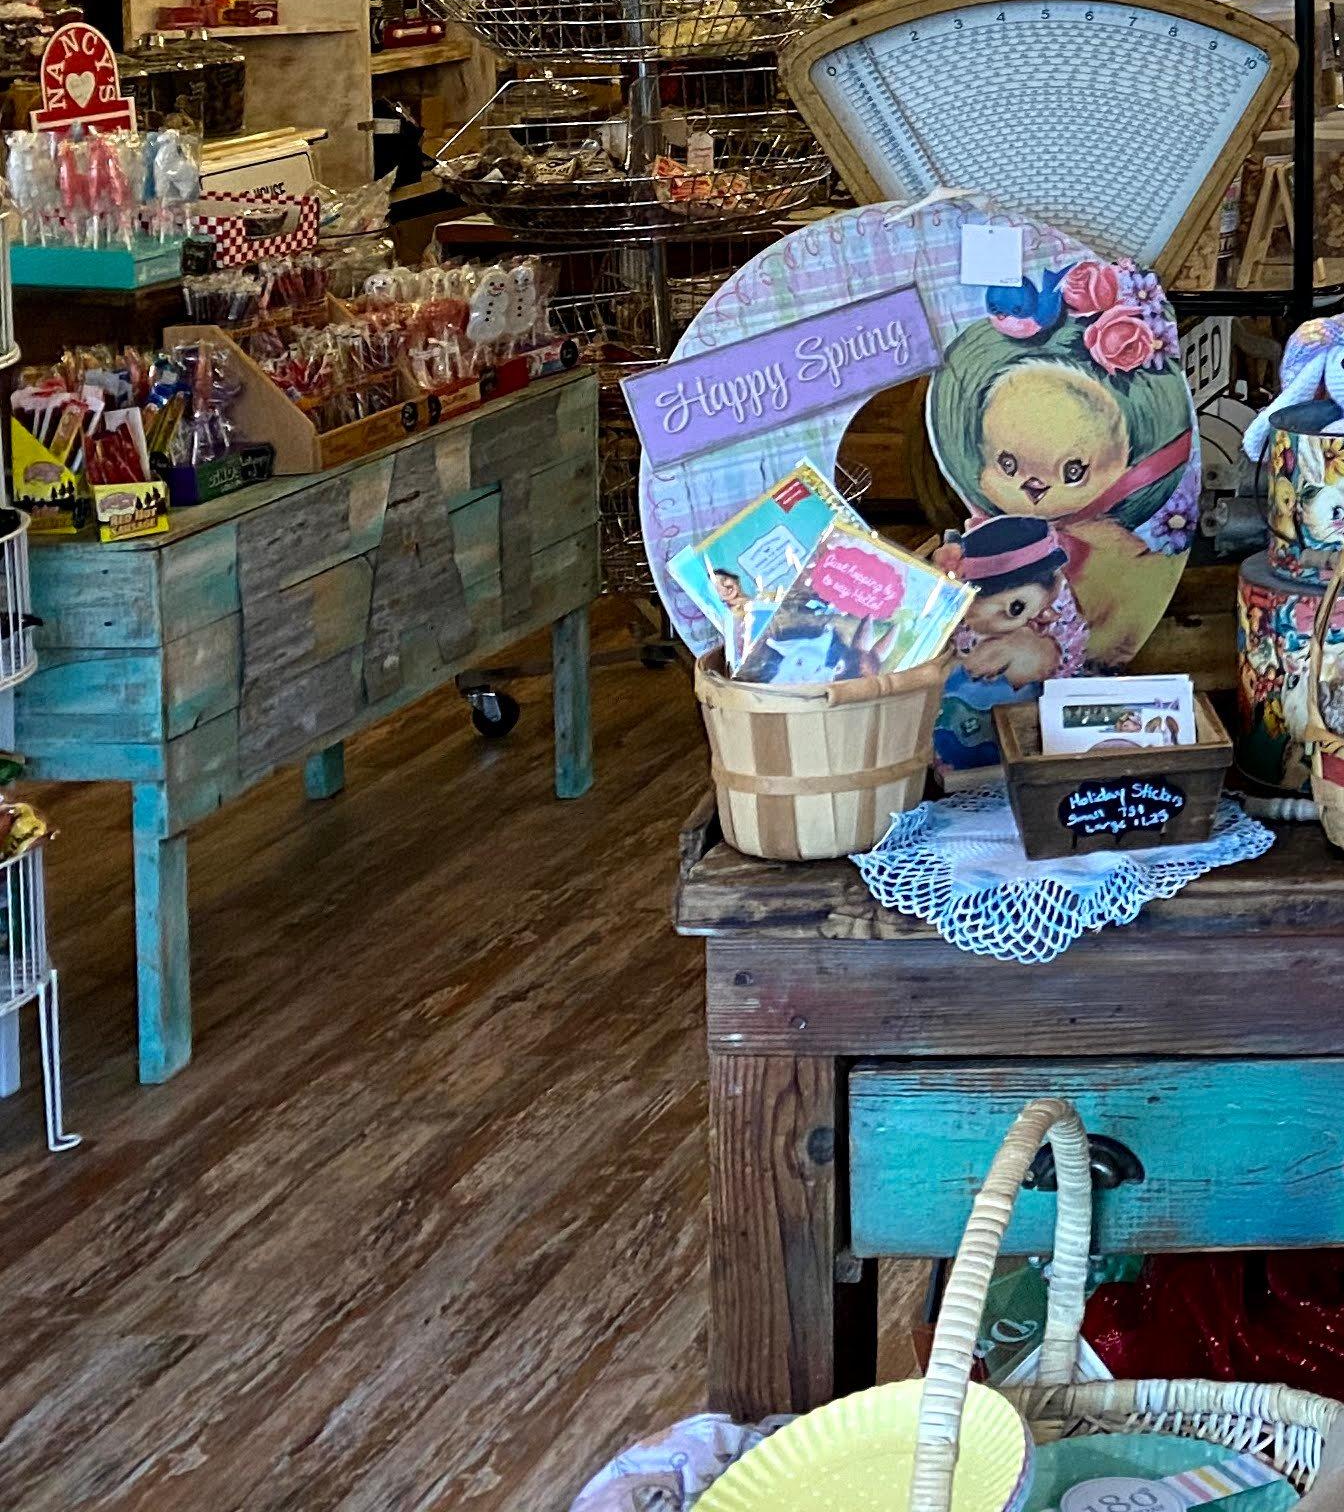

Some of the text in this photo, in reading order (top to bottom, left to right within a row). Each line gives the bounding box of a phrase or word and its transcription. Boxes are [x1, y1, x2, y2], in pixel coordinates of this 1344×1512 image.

[996, 12, 1006, 23] 4
[1040, 9, 1050, 20] 5
[1085, 10, 1095, 21] 6
[954, 19, 963, 30] 3
[1128, 16, 1138, 27] 7
[909, 31, 919, 42] 2
[1168, 26, 1178, 37] 8
[1209, 40, 1218, 51] 9
[1243, 56, 1258, 70] 10
[826, 66, 837, 77] 0
[655, 319, 911, 433] Happy Spring
[1069, 787, 1126, 809] Holiday
